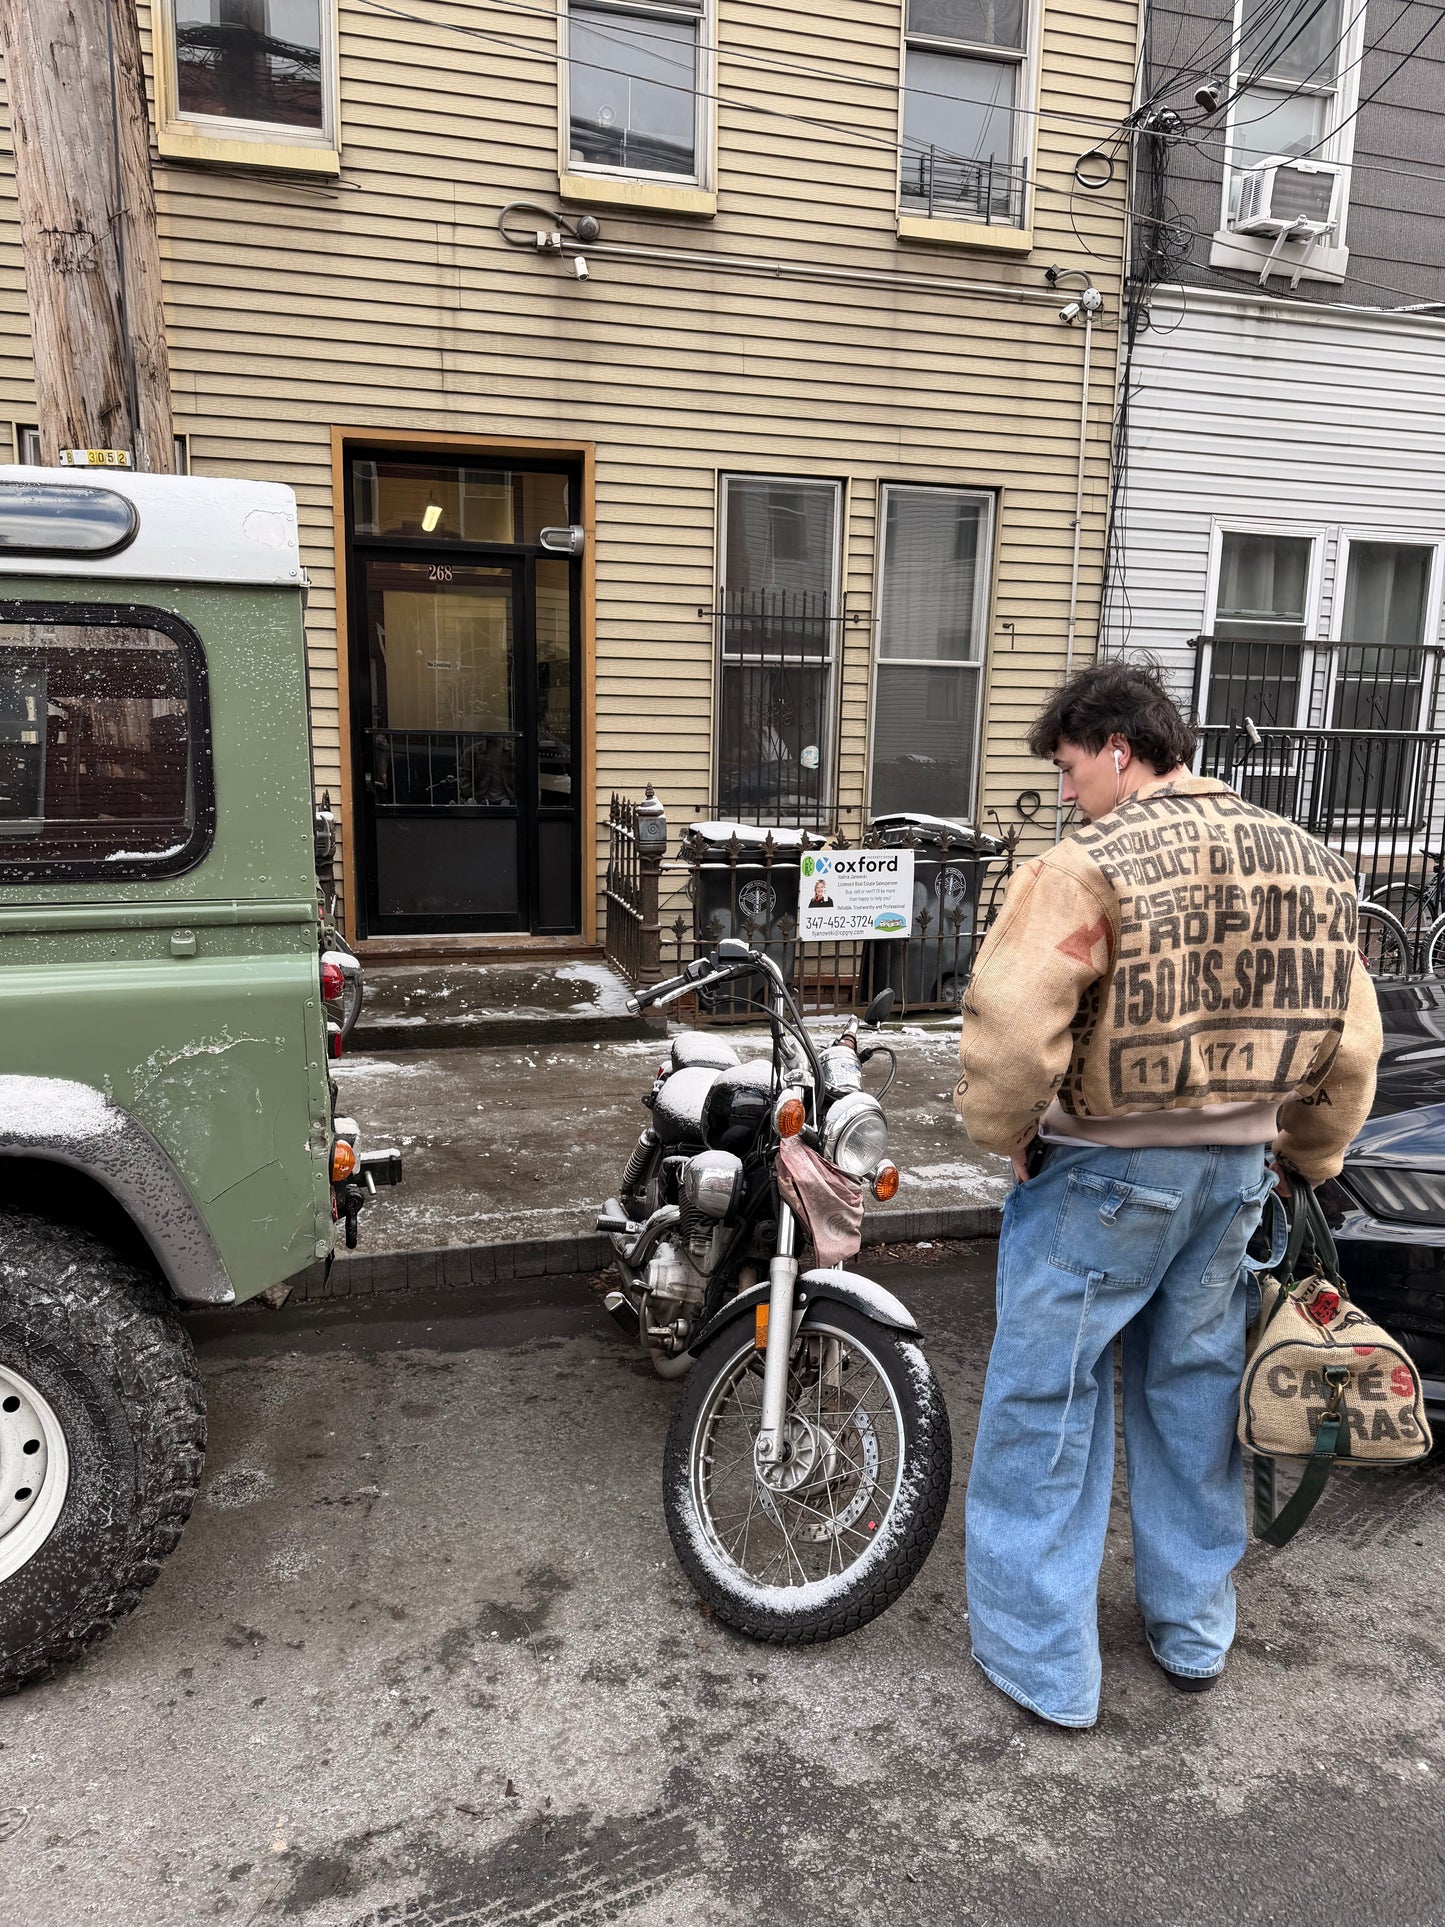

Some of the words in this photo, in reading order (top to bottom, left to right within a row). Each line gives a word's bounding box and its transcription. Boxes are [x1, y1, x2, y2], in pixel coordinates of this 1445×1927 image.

[88, 452, 126, 464] 3052
[428, 565, 453, 581] 268
[1088, 820, 1199, 863] PRODUCTO
[1203, 822, 1230, 843] DE
[834, 856, 898, 873] oxford
[1098, 845, 1200, 891] PRODUCT
[1209, 845, 1235, 876] OF
[1119, 884, 1248, 925] COSECHA
[805, 915, 874, 930] 347-452-3724
[1118, 910, 1252, 960] CROP
[1130, 1056, 1169, 1084] 11
[1203, 1042, 1254, 1073] 171
[1266, 1363, 1415, 1401] CAÉS
